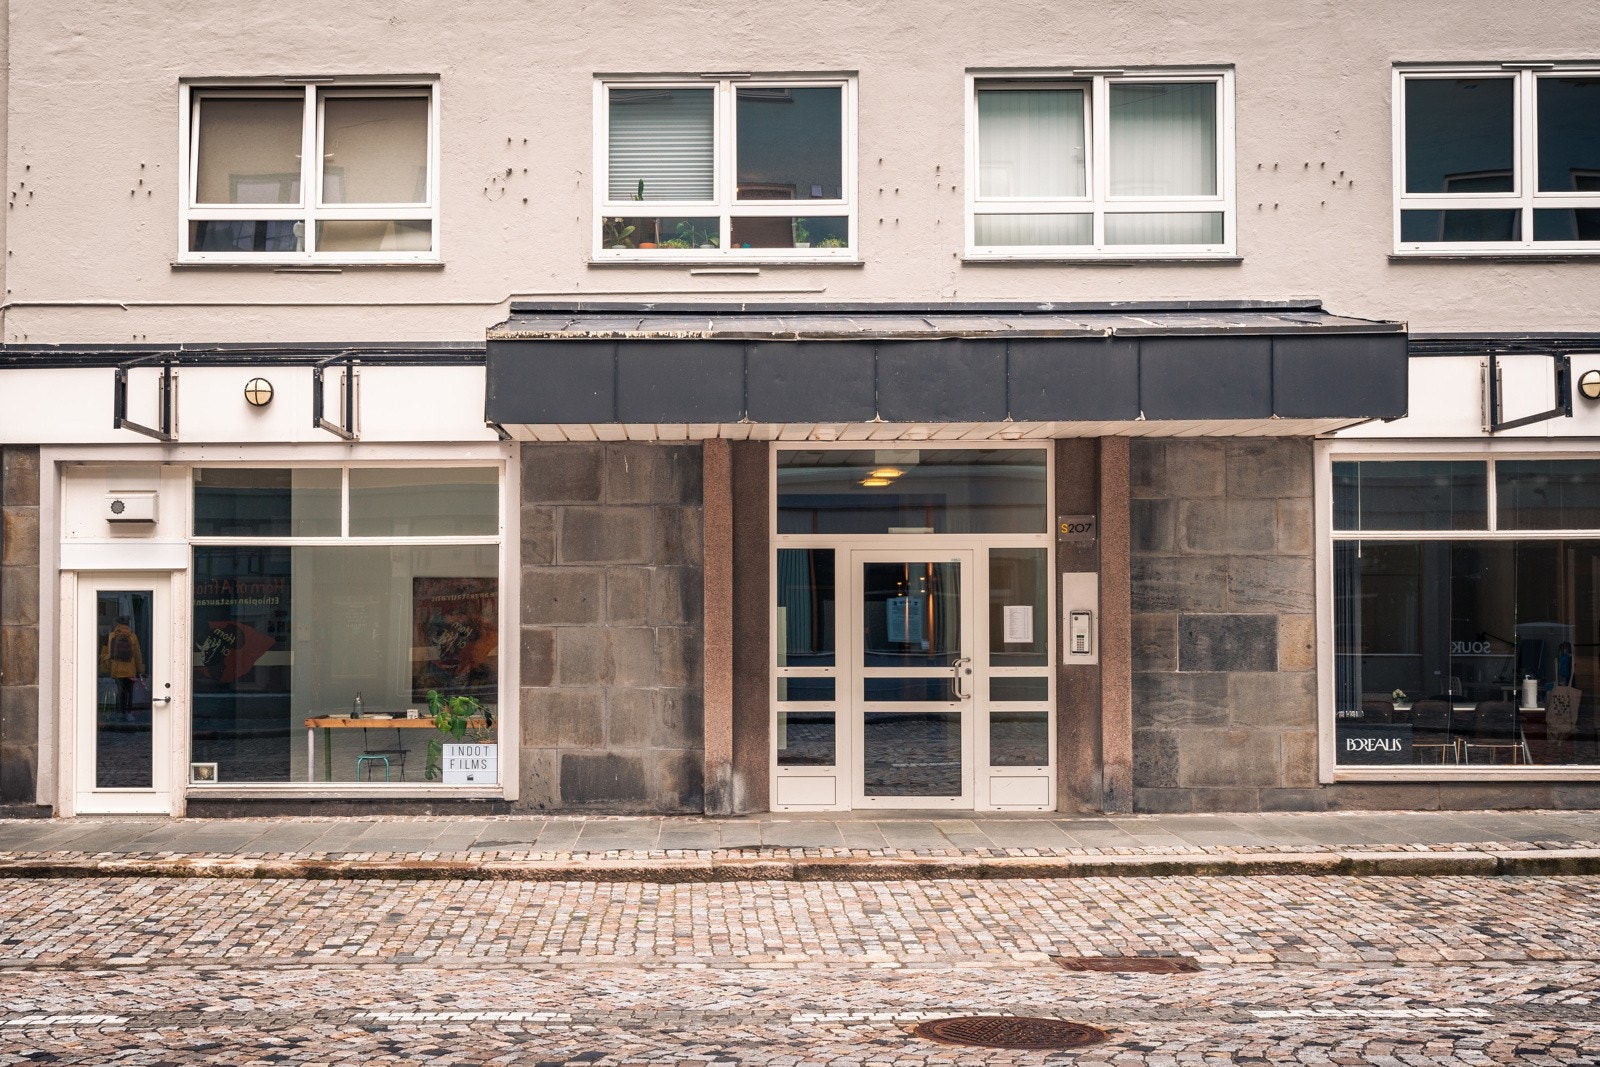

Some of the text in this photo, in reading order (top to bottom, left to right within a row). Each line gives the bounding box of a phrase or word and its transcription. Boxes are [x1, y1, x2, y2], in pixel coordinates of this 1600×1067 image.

[1061, 523, 1092, 534] S207
[1346, 738, 1402, 751] BOREALIS
[451, 745, 489, 756] INDOT
[450, 759, 487, 770] FILMS
